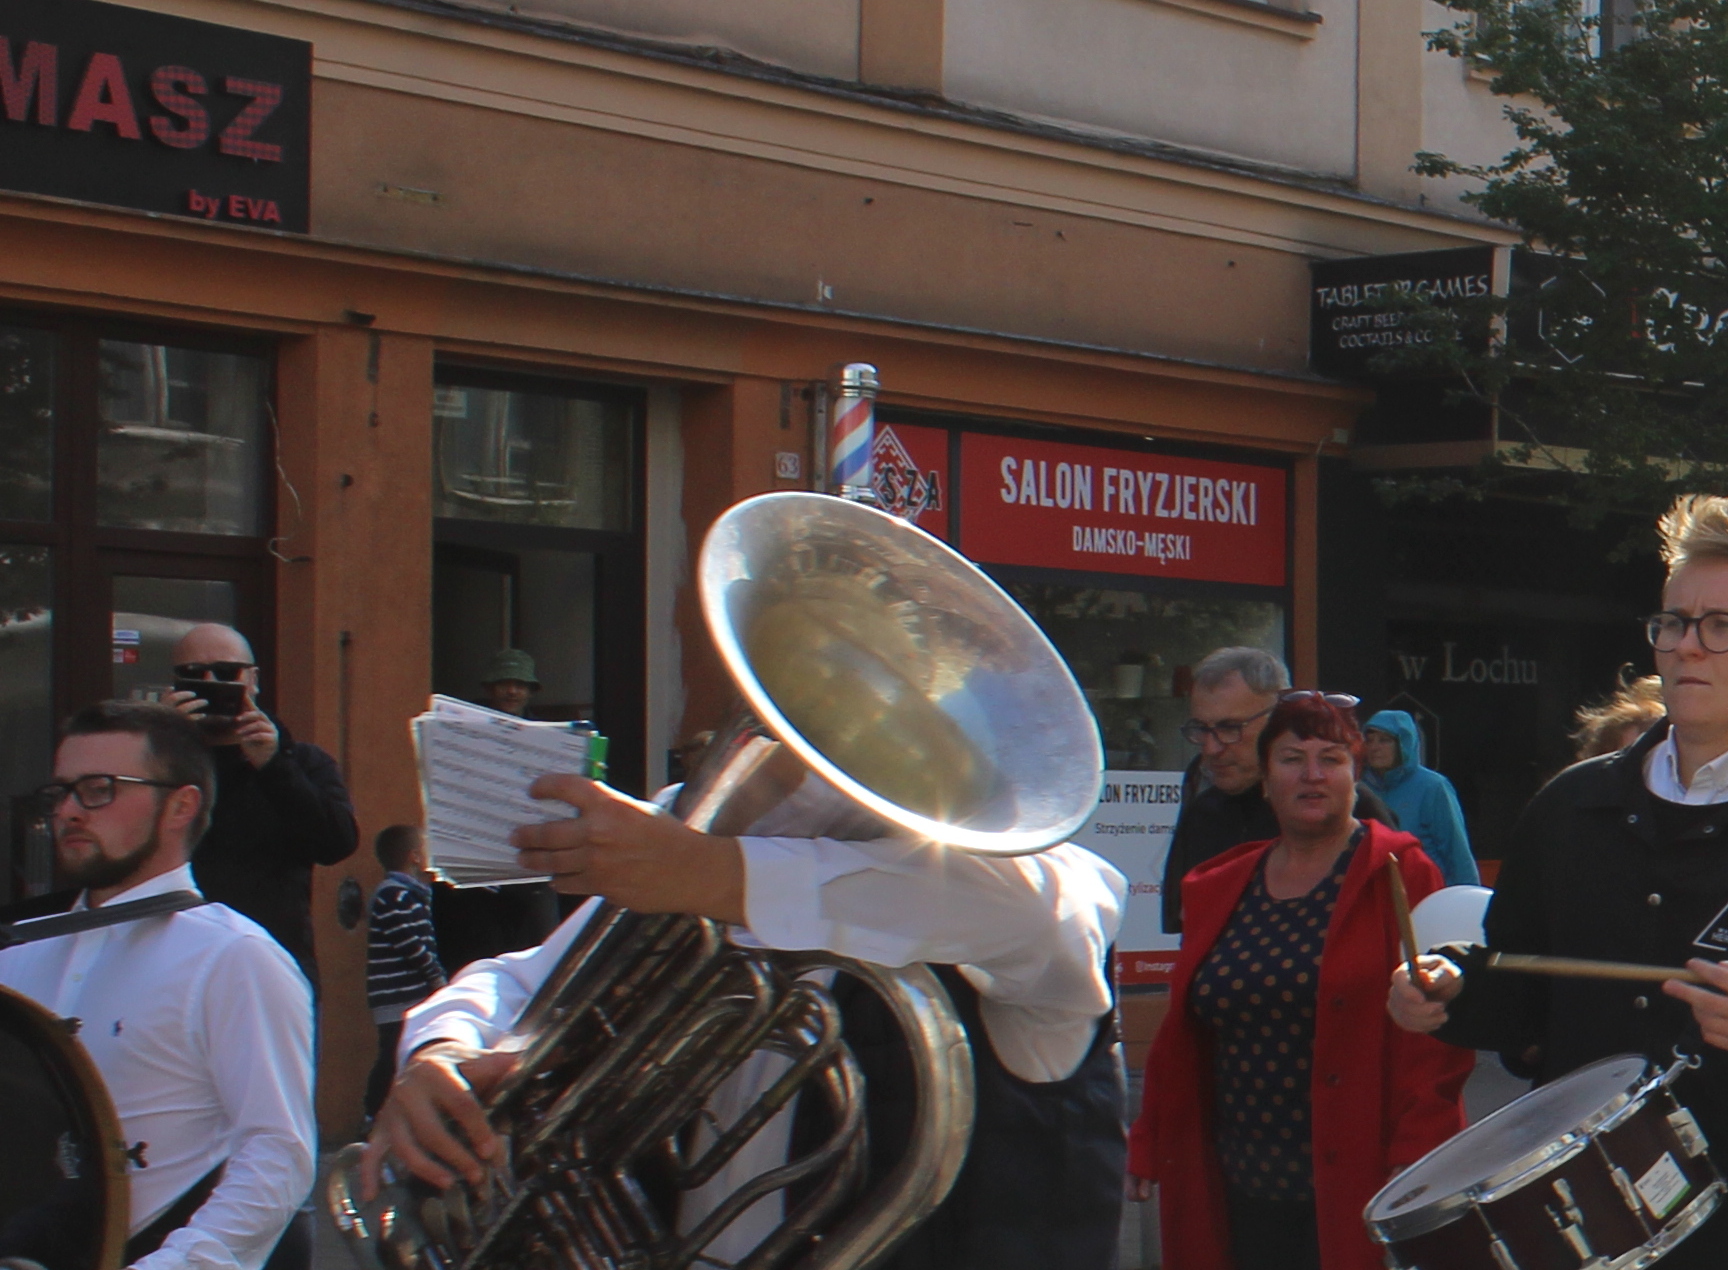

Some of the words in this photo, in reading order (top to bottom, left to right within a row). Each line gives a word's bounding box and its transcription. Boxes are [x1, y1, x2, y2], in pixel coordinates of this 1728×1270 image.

[188, 189, 219, 218] by
[228, 195, 281, 223] EVA
[1000, 456, 1093, 511] SALON
[1103, 466, 1257, 526] FRYZJERSKI
[1072, 525, 1191, 565] DAMSKO-MĘSKI
[1397, 655, 1429, 681] w
[1440, 640, 1539, 685] Lochu
[1125, 784, 1181, 804] FRYZJERS
[1094, 822, 1147, 837] Strzyżenie
[1148, 822, 1175, 834] dams
